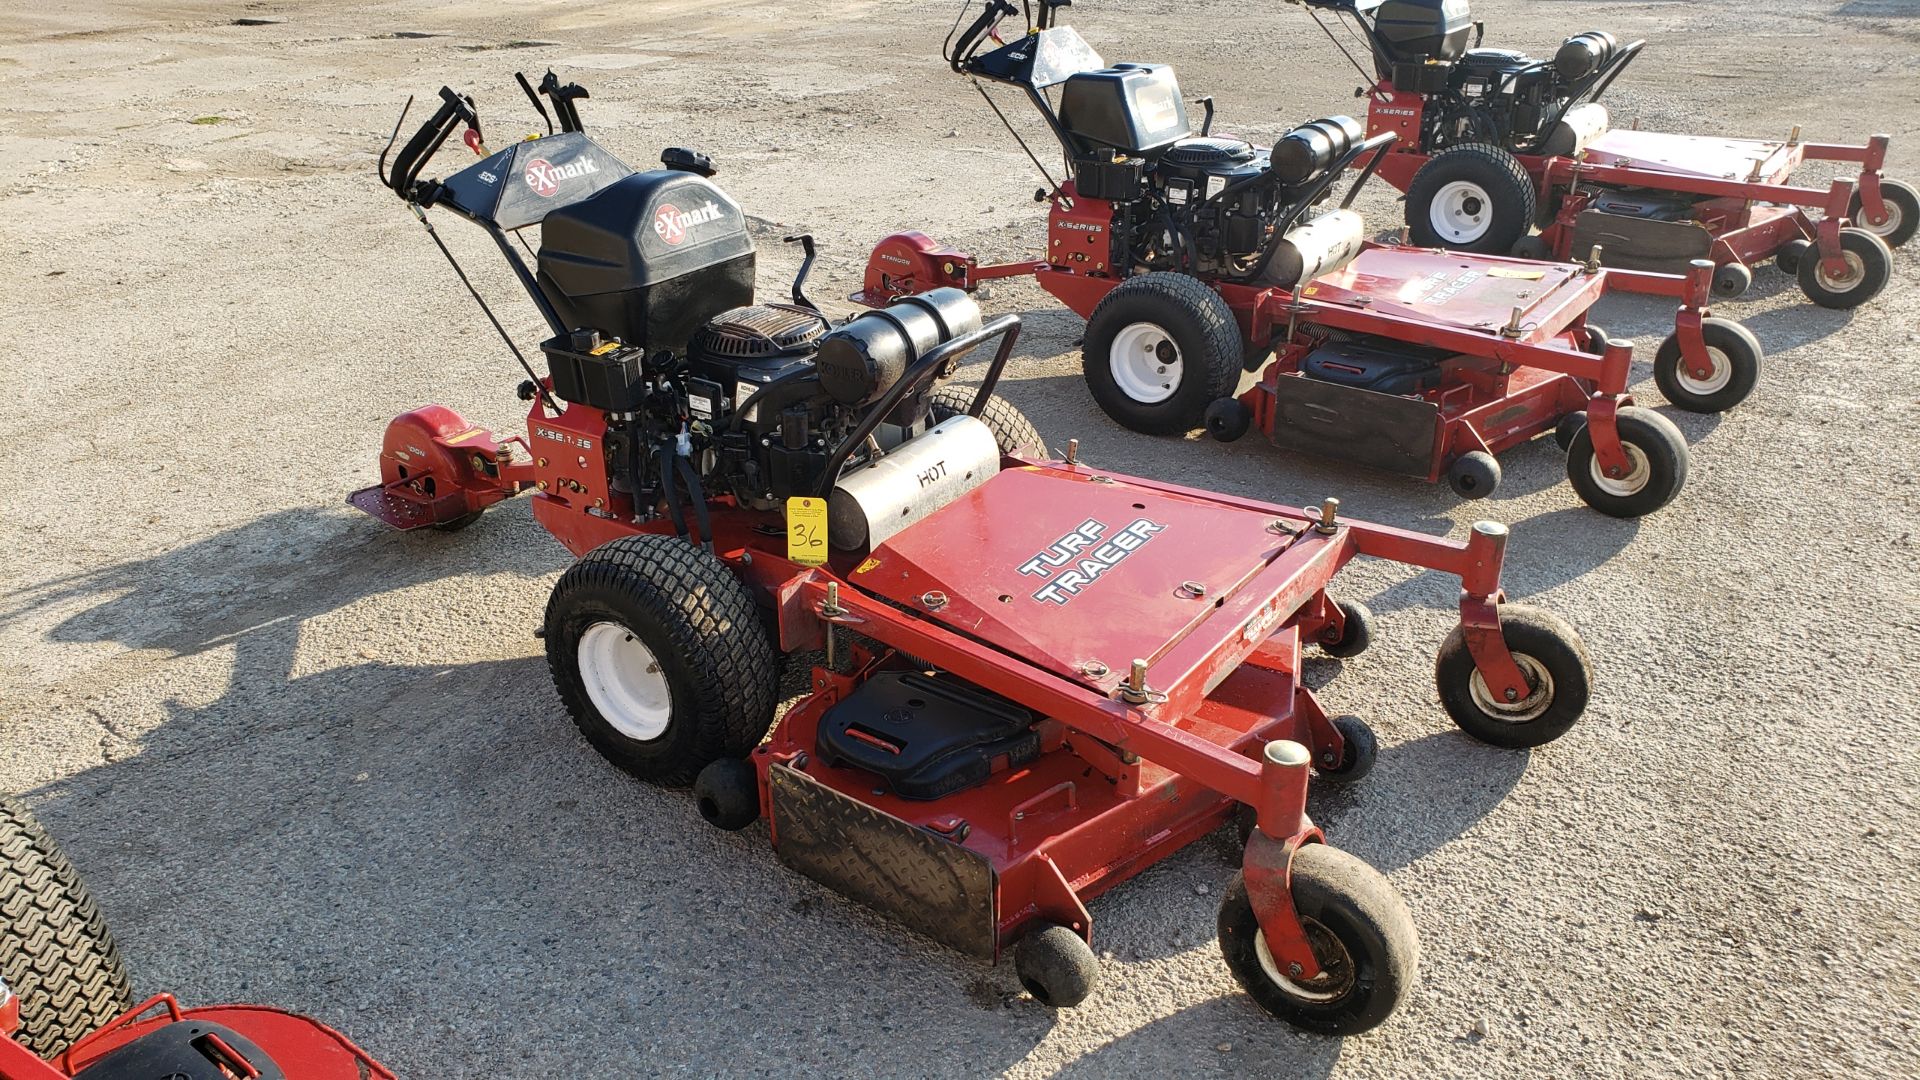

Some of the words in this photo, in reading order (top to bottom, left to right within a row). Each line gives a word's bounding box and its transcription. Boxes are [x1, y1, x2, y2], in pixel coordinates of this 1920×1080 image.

[1375, 107, 1415, 117] X-SERIES
[480, 170, 498, 184] ECS
[1056, 220, 1104, 233] X-SERIES
[916, 460, 948, 489] HOT
[791, 523, 824, 550] 36
[1016, 518, 1108, 579] TURF
[1032, 518, 1167, 605] TRACER
